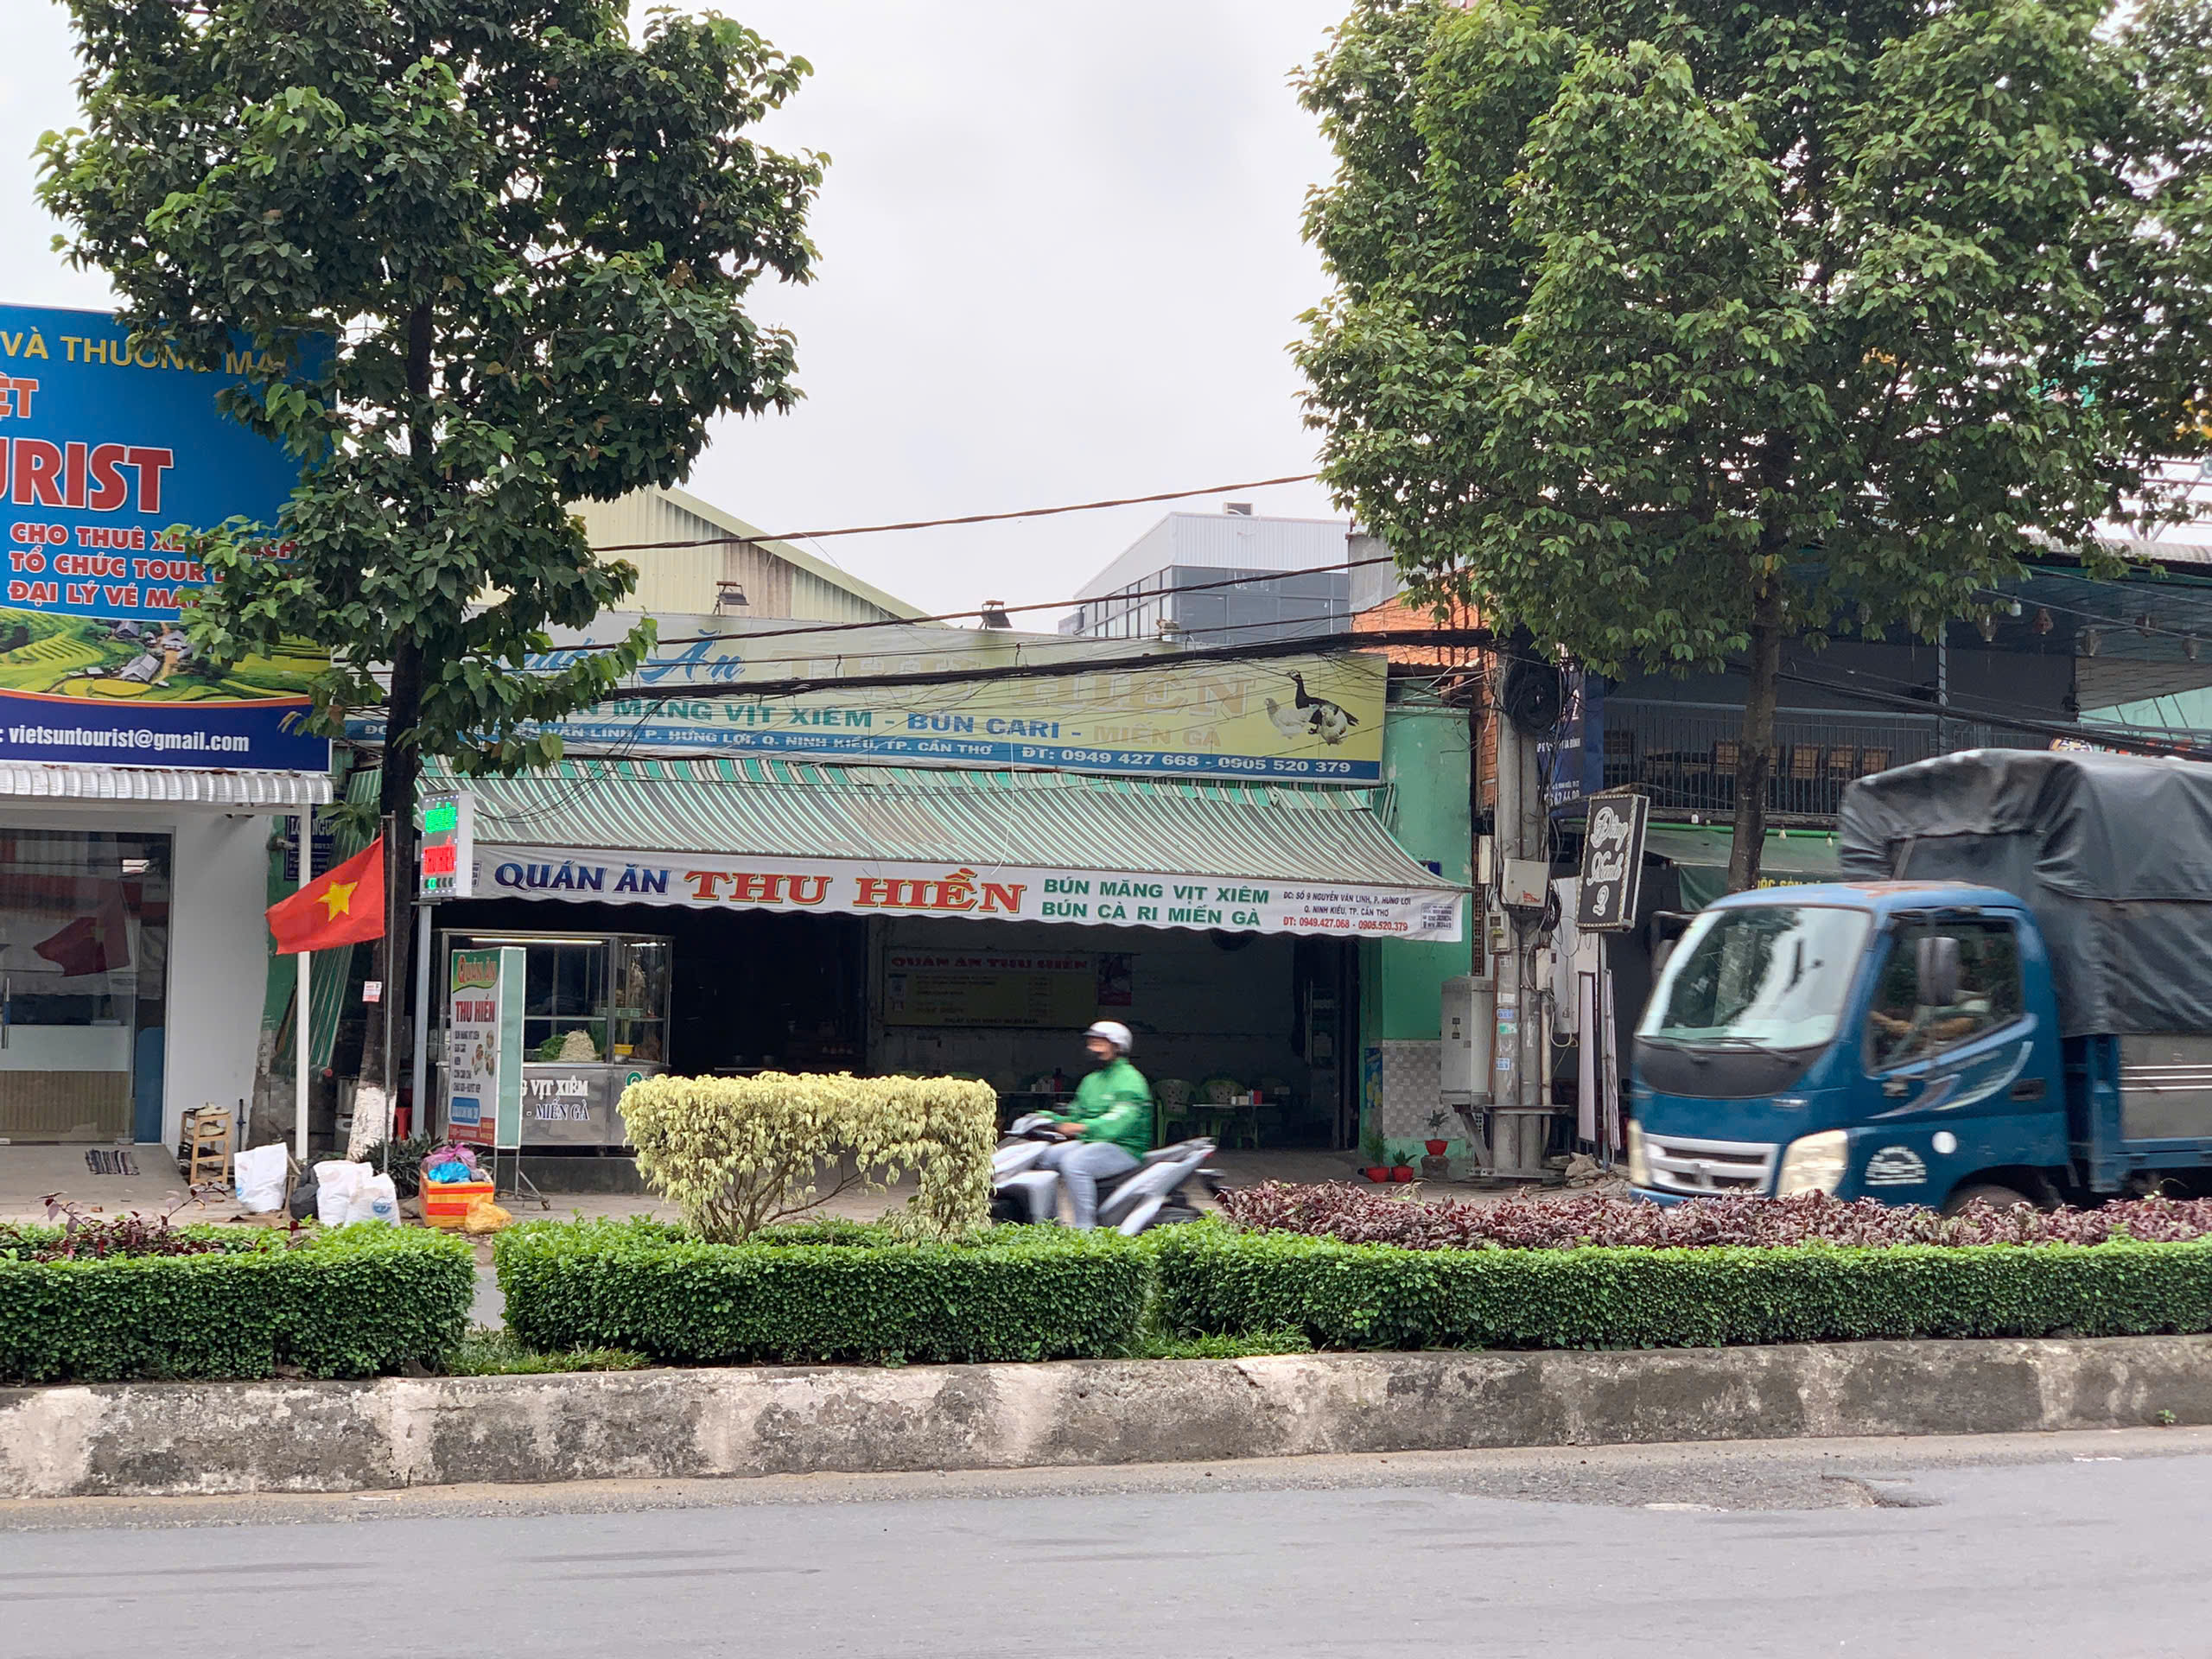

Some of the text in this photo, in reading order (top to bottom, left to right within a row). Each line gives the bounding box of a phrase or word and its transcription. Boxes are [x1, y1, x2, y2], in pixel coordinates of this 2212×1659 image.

[0, 326, 49, 359] VÀ
[0, 437, 174, 513] RIST
[10, 522, 68, 545] CHO
[75, 525, 145, 550] THUÊ
[9, 545, 46, 573] TỔ
[54, 551, 126, 578] CHỨC
[133, 559, 207, 582] TOUR
[8, 580, 58, 607] ĐẠI
[67, 580, 99, 605] LÝ
[104, 582, 138, 607] VÉ
[10, 724, 250, 753] vietsuntourist@gmail.com
[906, 709, 974, 734] BÚN
[986, 717, 1060, 739] CARI
[547, 725, 584, 737] VĂN
[645, 731, 662, 740] P.
[762, 735, 779, 746] Q.
[785, 736, 829, 747] NINH
[957, 743, 994, 754] THƠ
[1021, 747, 1054, 760] ĐT:
[1061, 749, 1112, 764] 0949
[1118, 752, 1155, 765] 427
[1161, 754, 1199, 766] 668
[1217, 757, 1267, 770] 0905
[1273, 760, 1309, 772] 520
[1314, 761, 1351, 773] 379
[494, 860, 607, 892] QUÁN
[613, 863, 671, 895] ĂN
[683, 870, 831, 906] THU
[852, 868, 1028, 913] HIỀN
[1043, 876, 1269, 905] BÚN MĂNG VỊT XIÊM
[1041, 899, 1262, 926] BÚN CÀ RI MIẾN GÀ
[1283, 916, 1296, 926] ĐT:
[1358, 919, 1408, 931] 0905.520.379
[455, 1001, 473, 1023] THU
[530, 1079, 554, 1101] VỊT
[556, 1074, 588, 1096] XIÊM
[535, 1096, 569, 1121] MIẾN
[570, 1099, 590, 1121] GÀ
